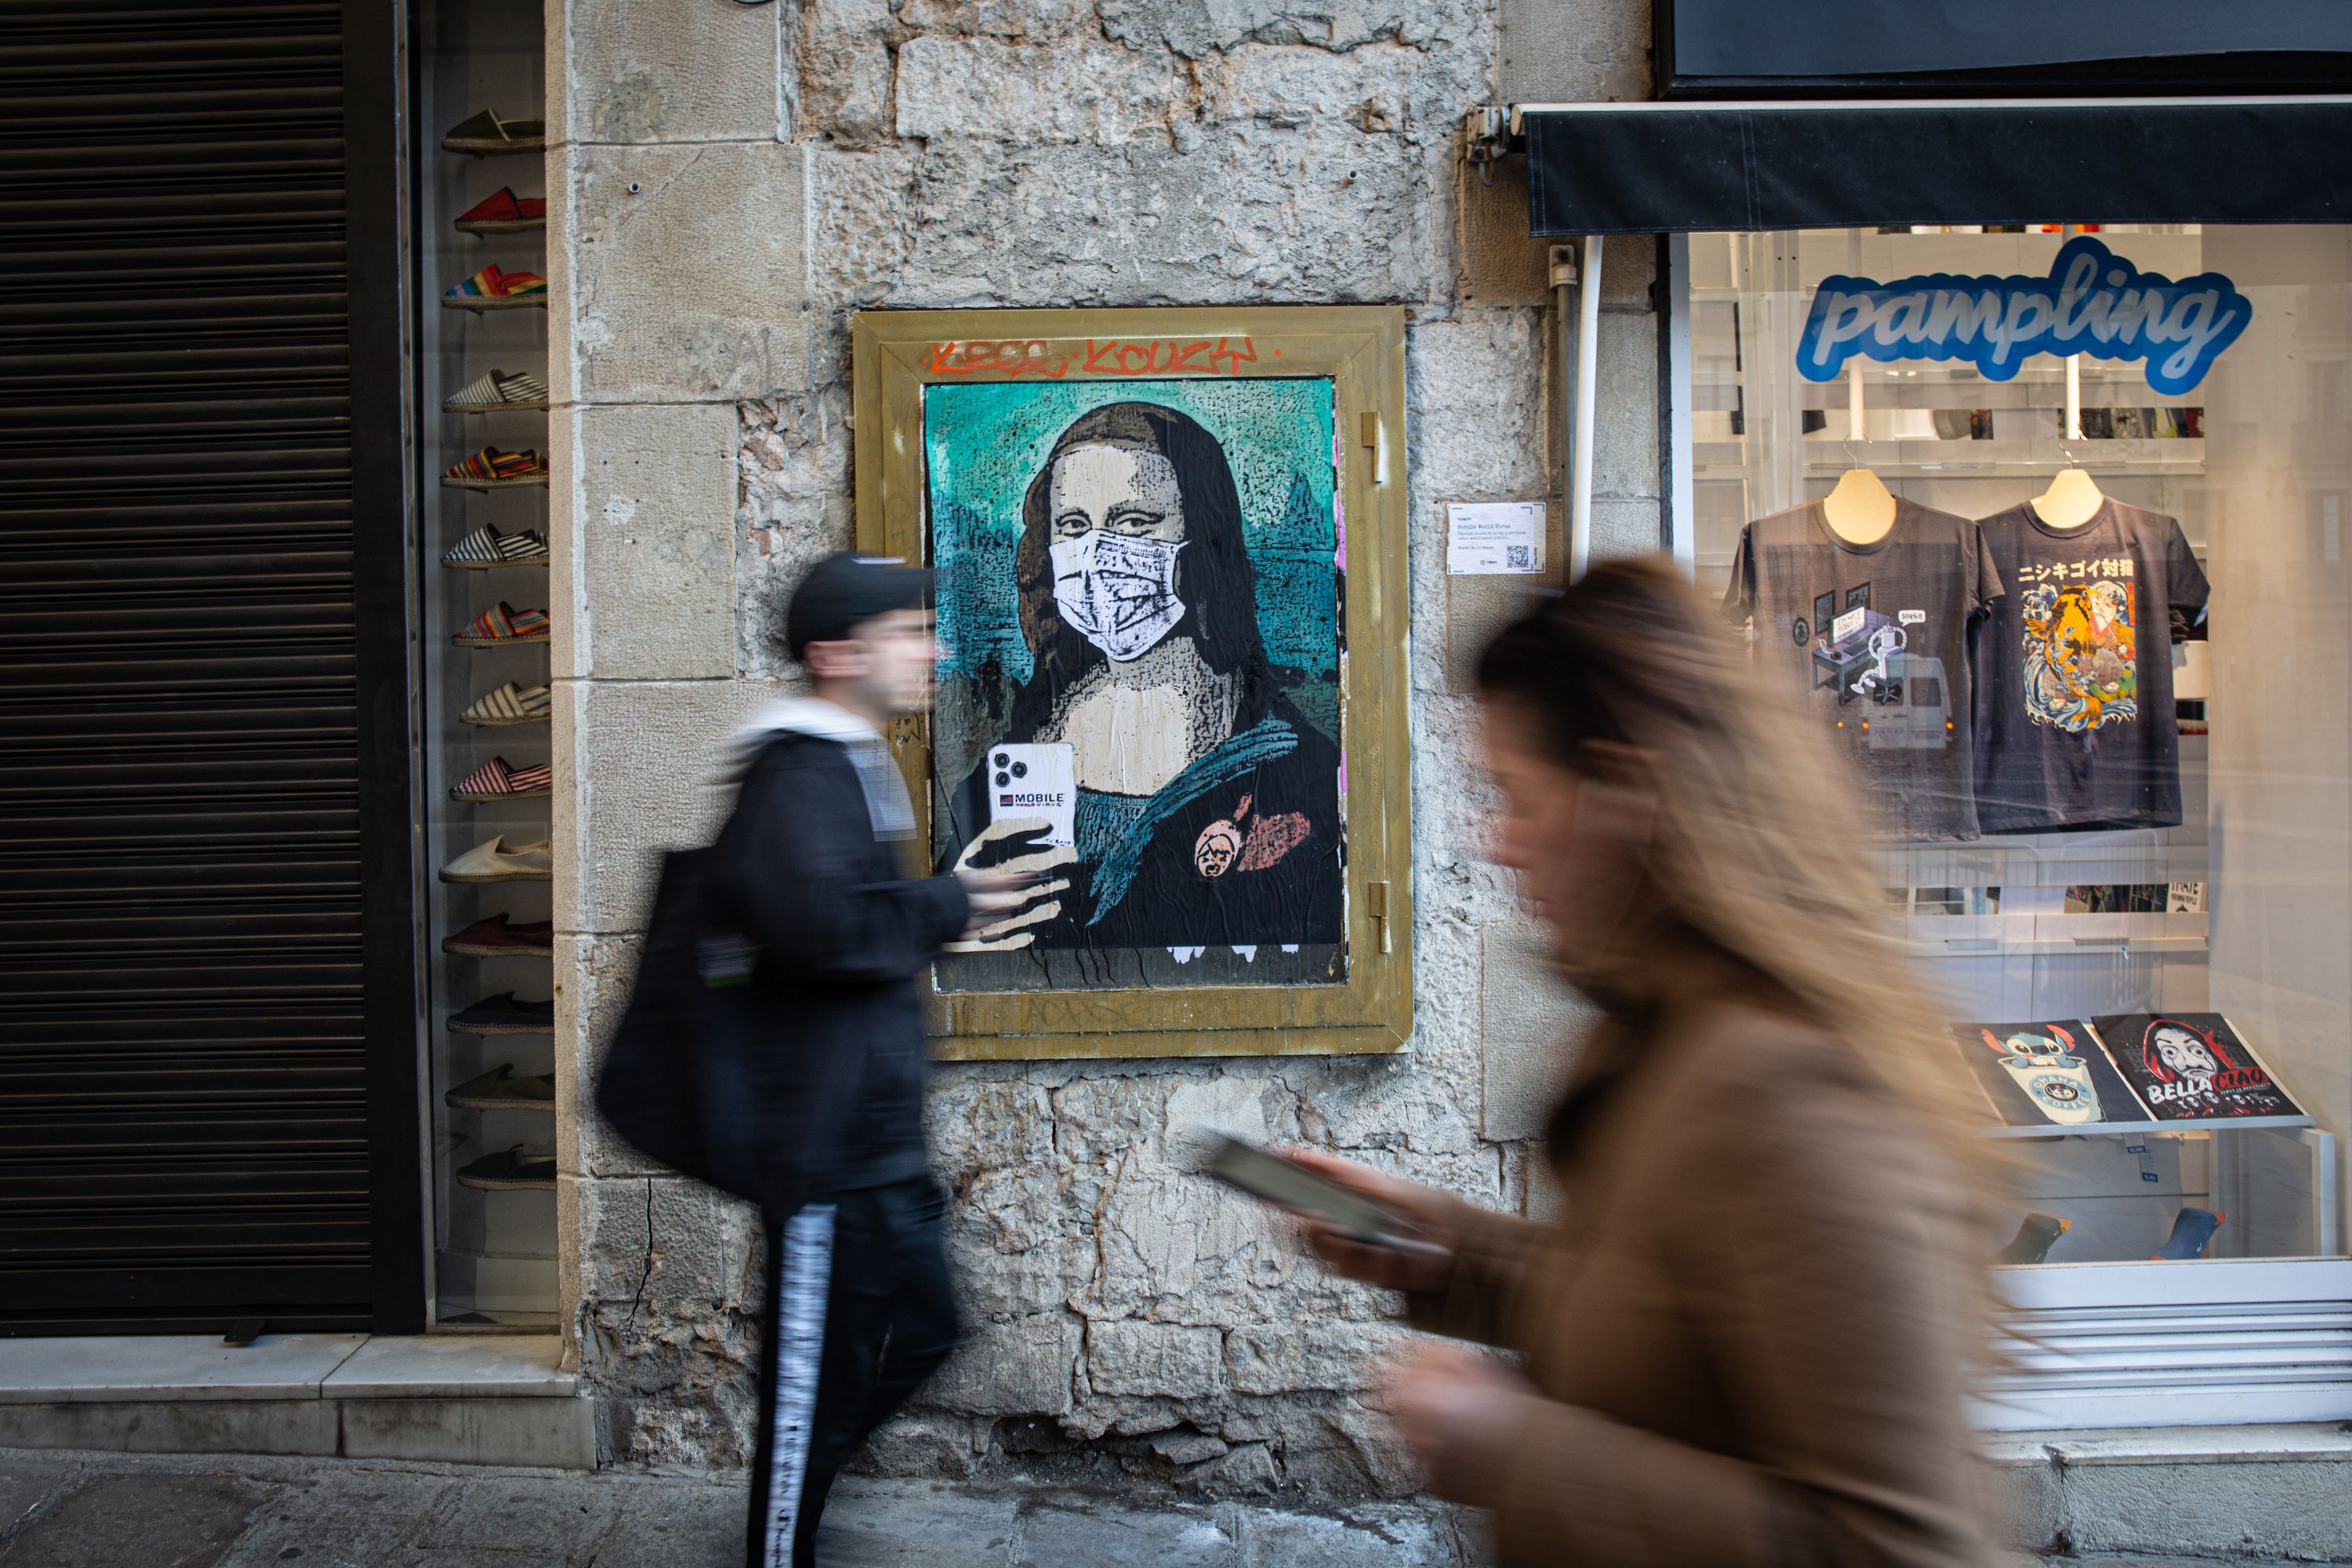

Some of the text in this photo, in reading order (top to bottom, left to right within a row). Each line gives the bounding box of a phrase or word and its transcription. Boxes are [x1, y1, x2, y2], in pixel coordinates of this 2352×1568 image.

[1813, 252, 2237, 380] pampling
[2017, 557, 2134, 583] ニシキゴイ対猫
[1014, 793, 1064, 803] MOBILE
[2033, 1076, 2078, 1088] OHANA
[2146, 1069, 2263, 1105] BELLA CIAO
[2042, 1096, 2090, 1109] COFFEE
